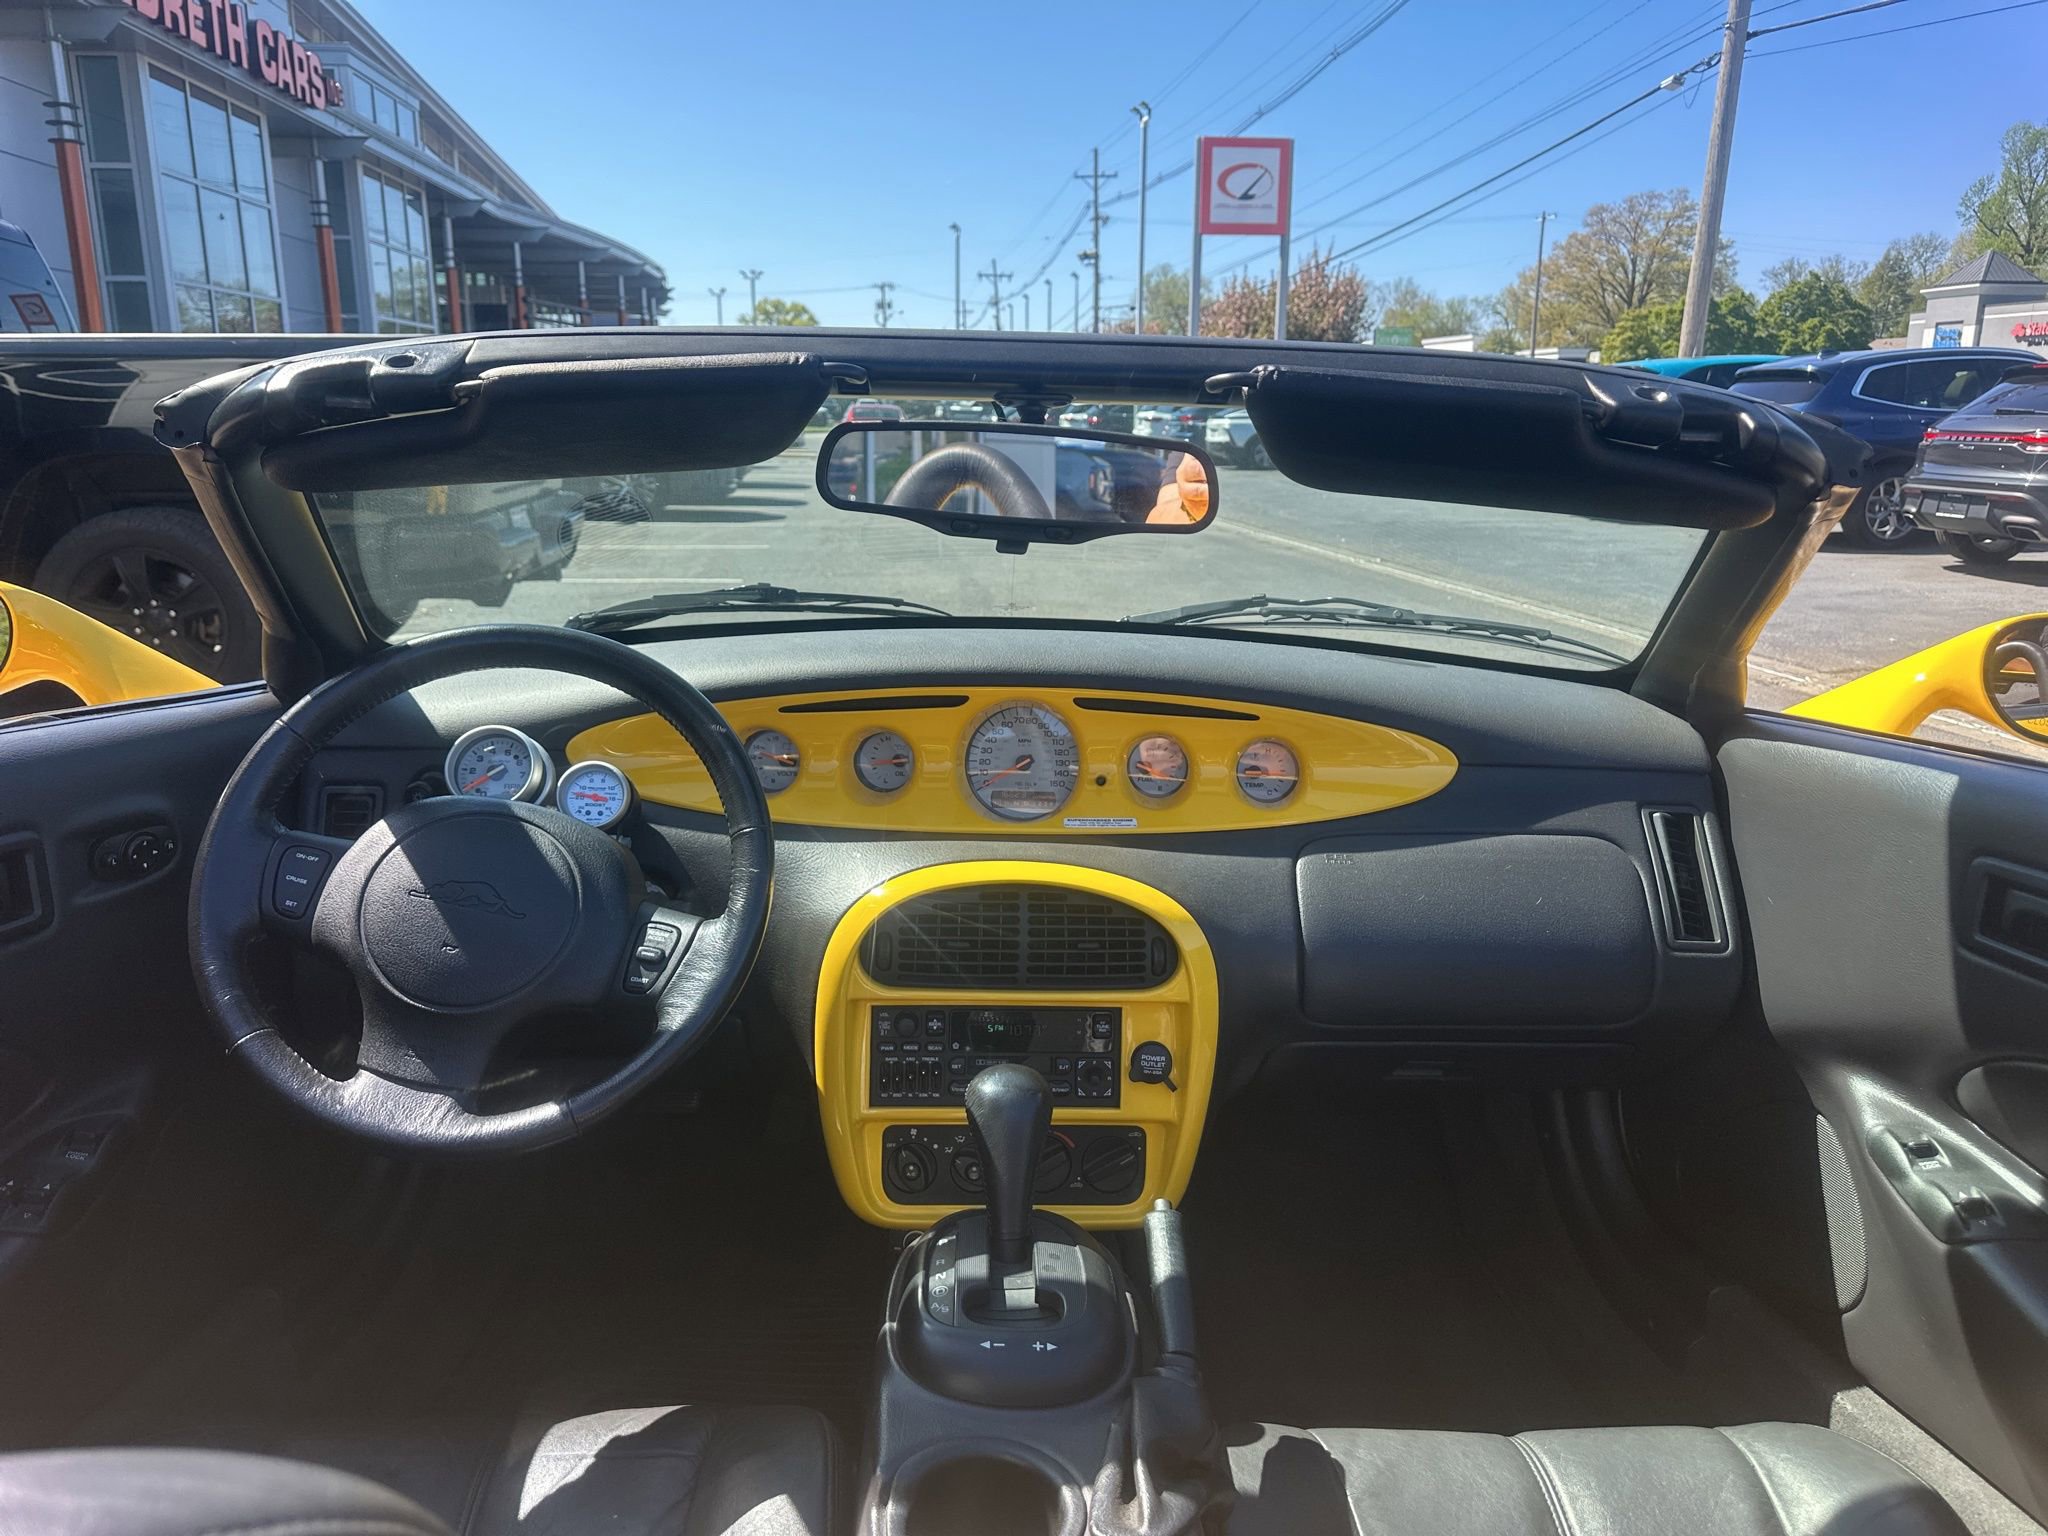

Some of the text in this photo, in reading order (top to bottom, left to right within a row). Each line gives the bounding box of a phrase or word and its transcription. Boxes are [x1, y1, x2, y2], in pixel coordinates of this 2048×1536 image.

[256, 18, 327, 111] CARS
[1026, 717, 1038, 725] 80
[1038, 722, 1050, 730] 90
[1050, 780, 1066, 788] 150
[295, 852, 320, 862] ON-OFF
[285, 874, 308, 885] CRUISE
[1141, 1054, 1166, 1062] POWER
[935, 1271, 947, 1280] N
